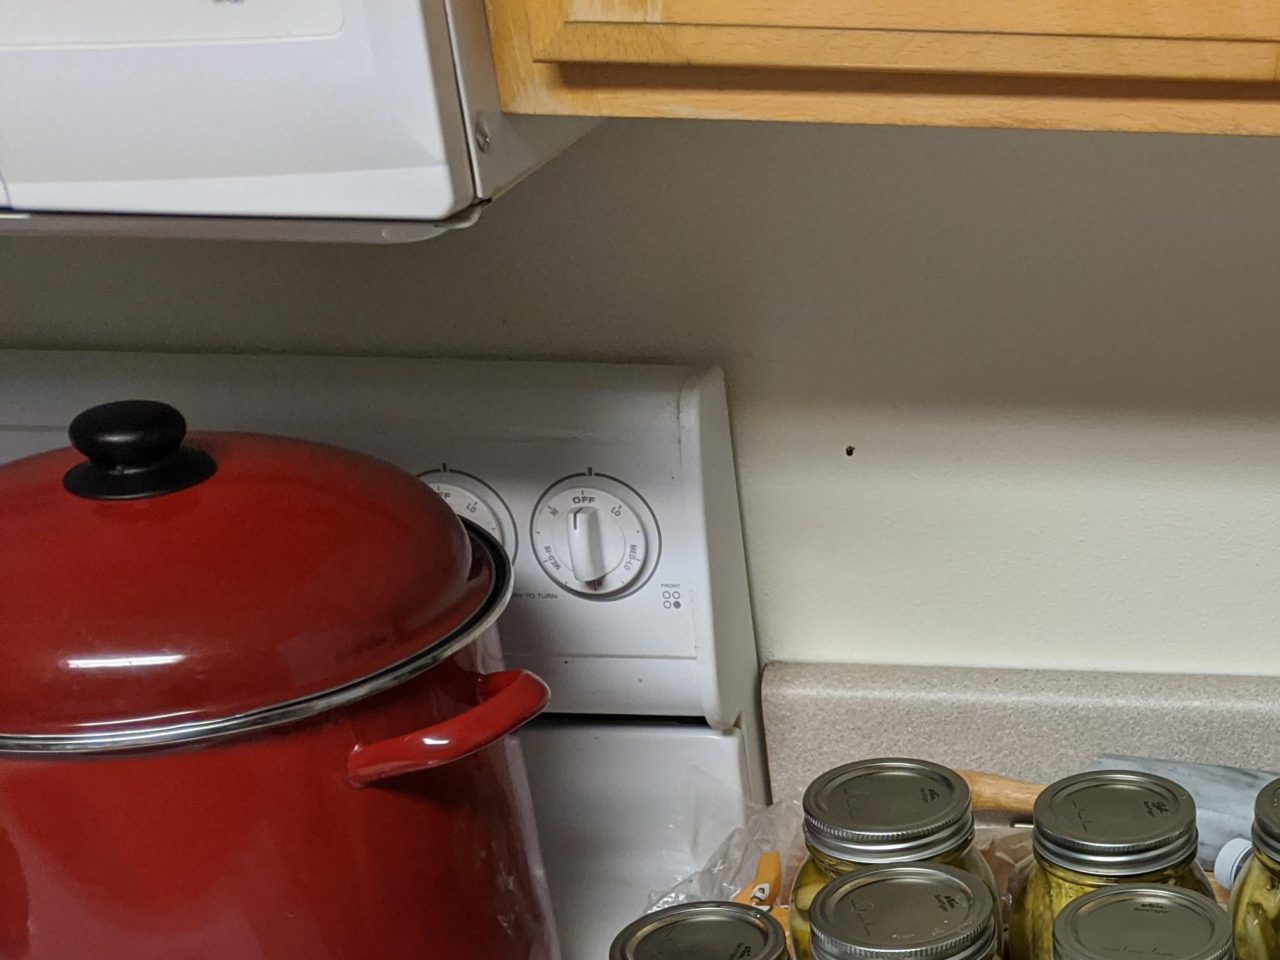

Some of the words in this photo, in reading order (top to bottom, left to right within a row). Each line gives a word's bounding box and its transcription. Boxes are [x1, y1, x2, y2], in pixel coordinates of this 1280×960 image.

[572, 496, 595, 504] OFF
[466, 502, 478, 513] LO
[610, 506, 621, 517] LO
[623, 544, 637, 571] MED-LO
